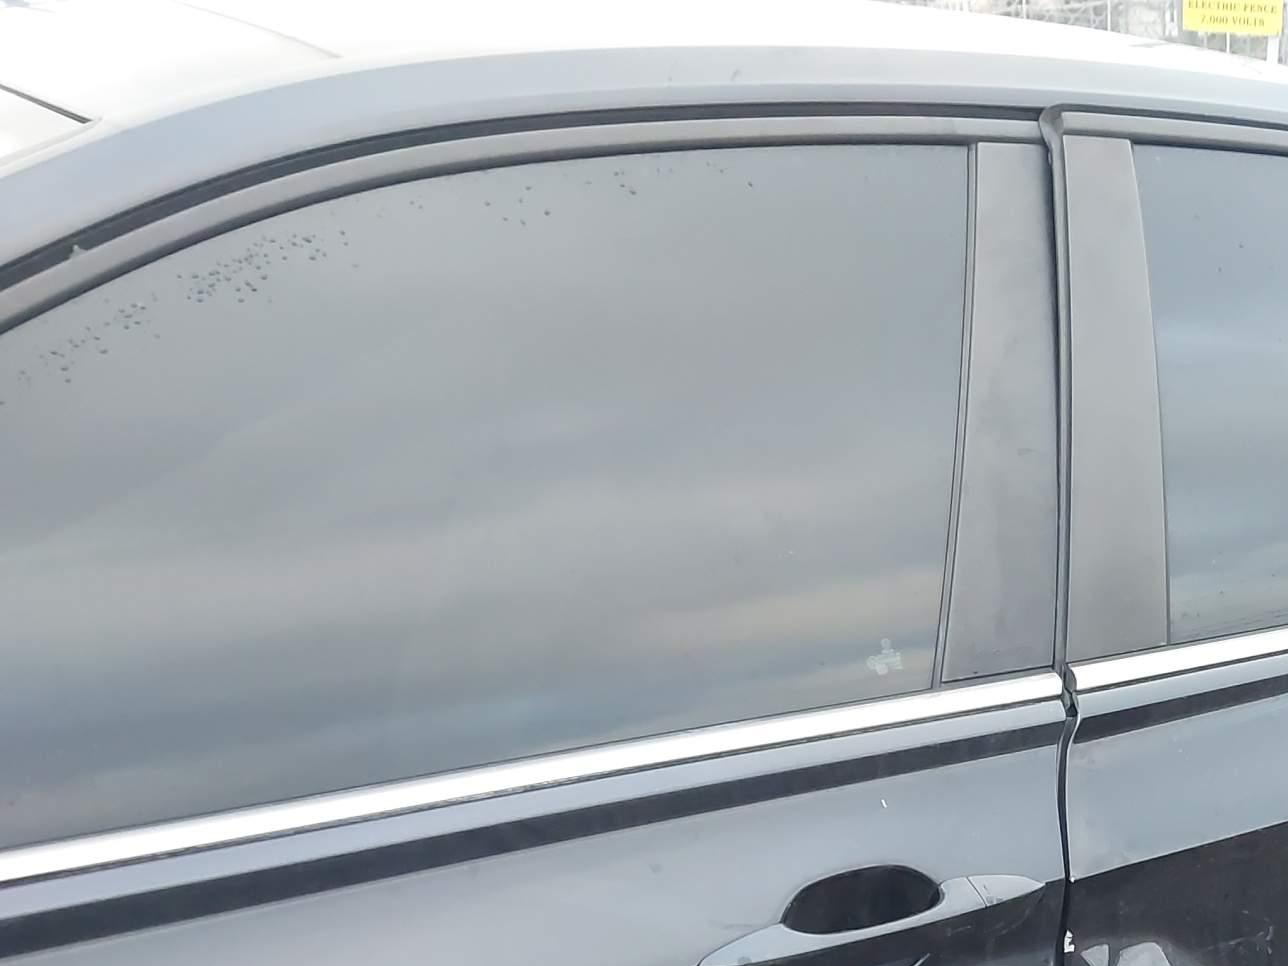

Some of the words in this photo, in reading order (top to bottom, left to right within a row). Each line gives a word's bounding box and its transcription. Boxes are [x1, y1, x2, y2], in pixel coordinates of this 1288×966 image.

[1188, 0, 1241, 11] ELECTRIC
[1243, 3, 1278, 14] FENCE
[1232, 16, 1265, 27] VOLTS
